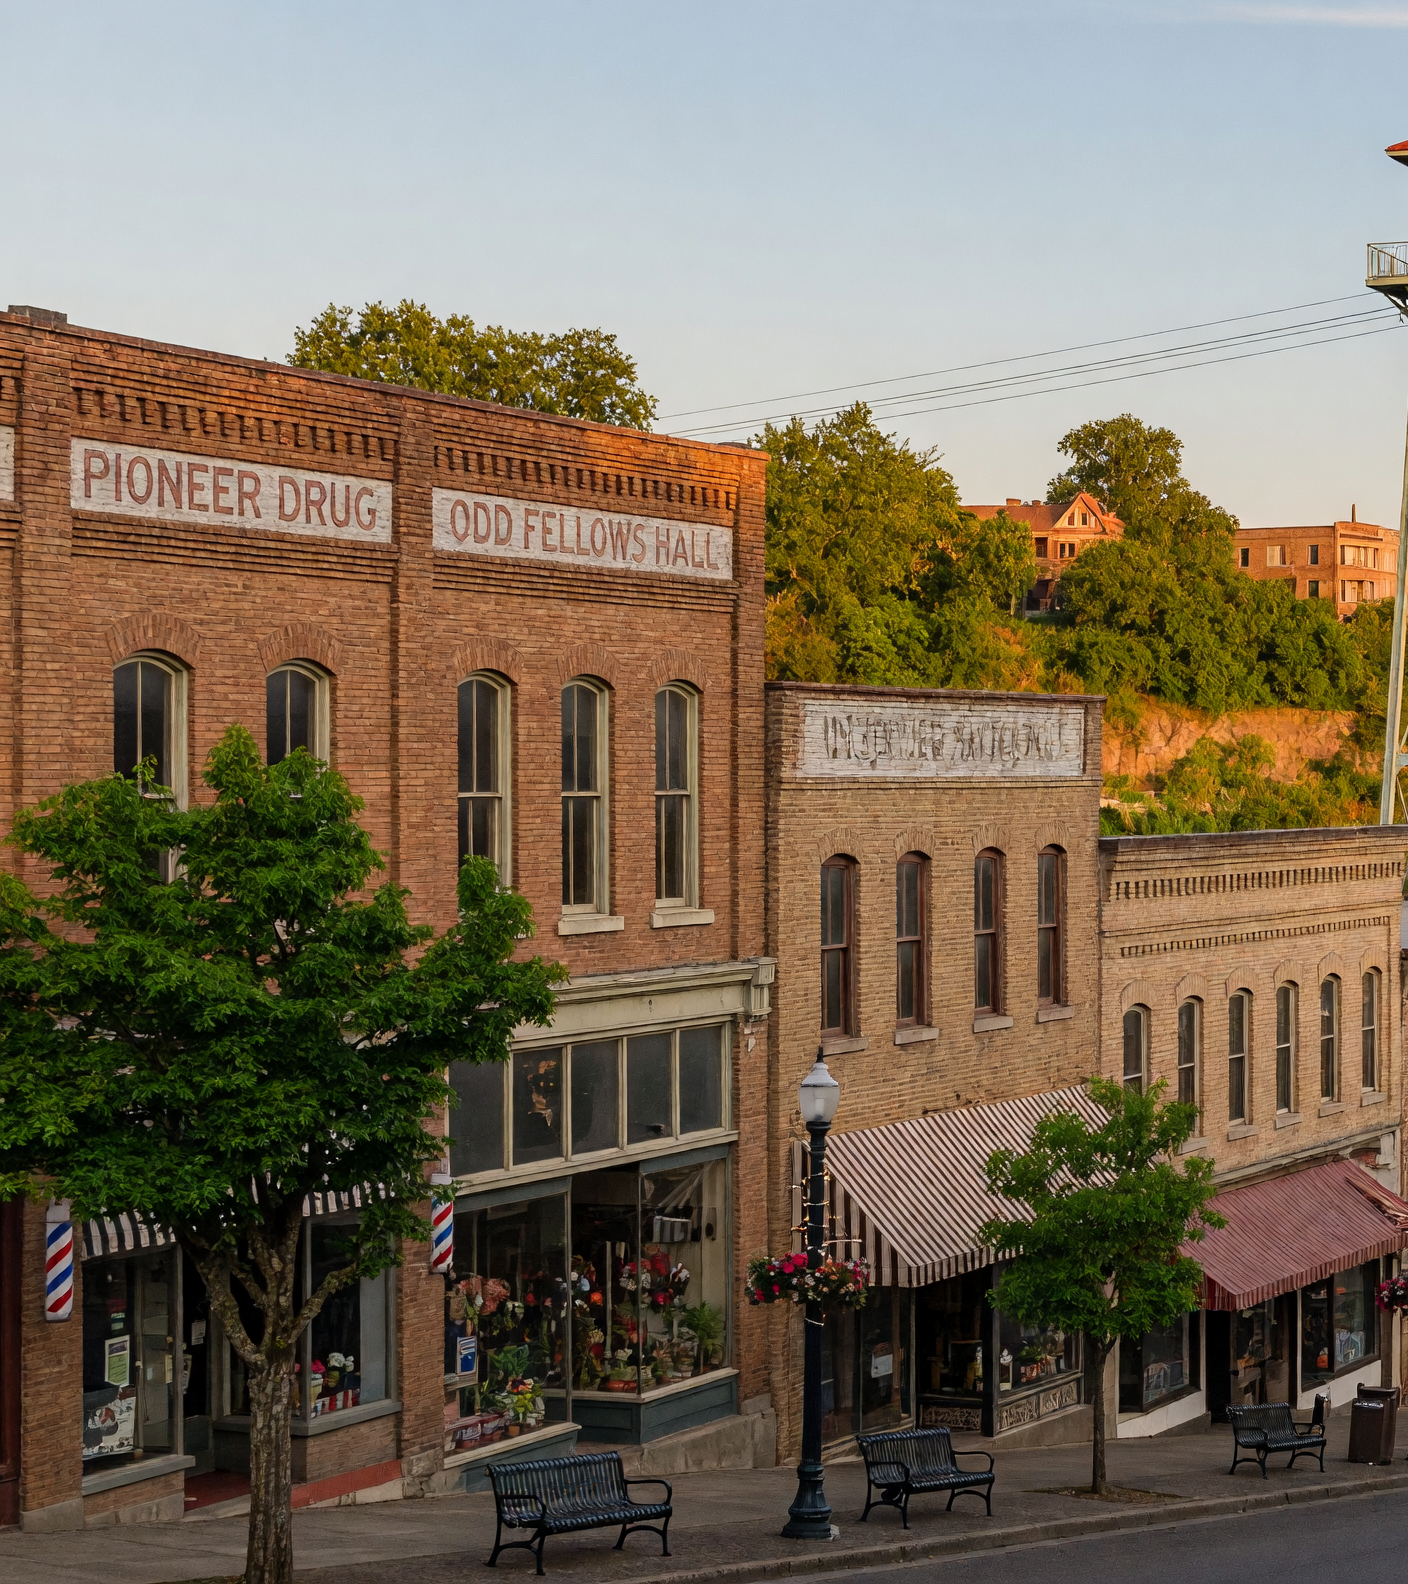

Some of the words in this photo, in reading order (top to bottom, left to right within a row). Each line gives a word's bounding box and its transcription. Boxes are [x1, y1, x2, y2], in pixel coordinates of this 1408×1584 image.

[84, 448, 262, 519] PIONEER
[278, 475, 377, 532] DRUG
[523, 507, 647, 564] FELLOWS
[655, 525, 720, 570] HALL
